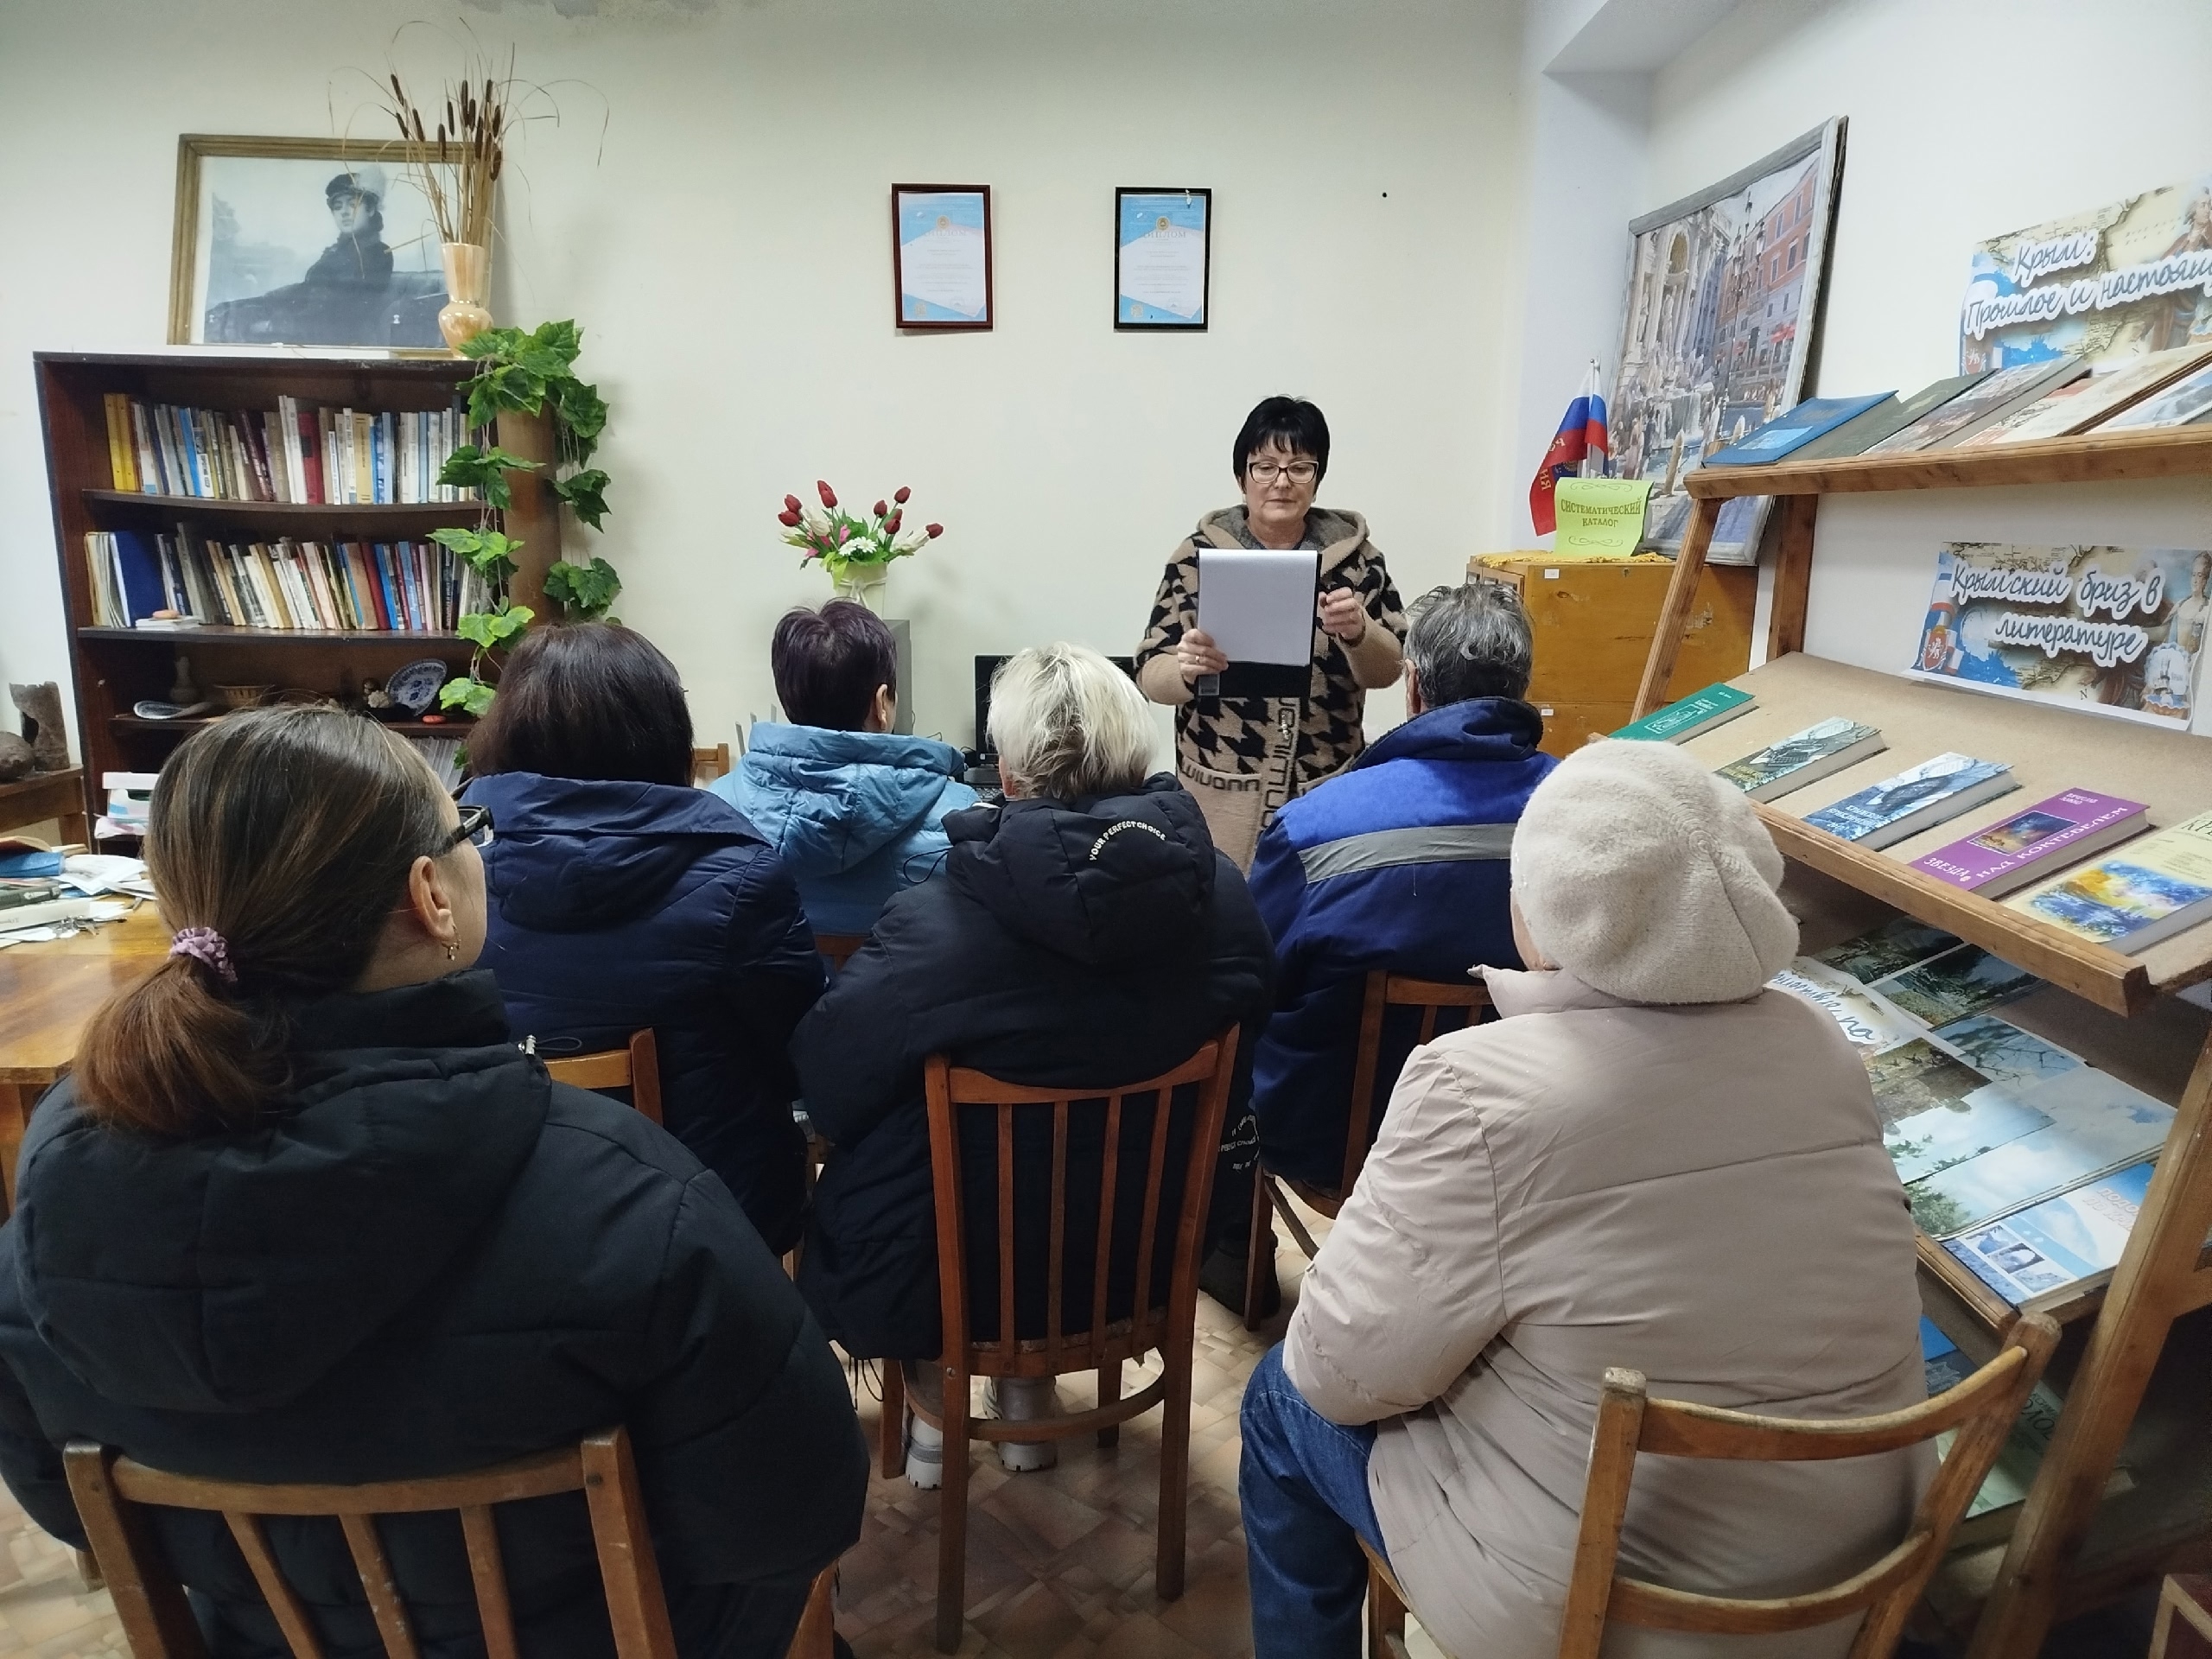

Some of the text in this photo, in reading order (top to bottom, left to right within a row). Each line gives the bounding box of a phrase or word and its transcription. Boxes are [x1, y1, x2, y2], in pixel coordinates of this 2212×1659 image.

[2015, 235, 2097, 278] Крым:
[1965, 288, 2063, 335] Прошлое
[2069, 286, 2094, 309] и
[1560, 496, 1643, 515] СИСТЕМАТИЧЕСКИЙ
[1582, 518, 1619, 528] КАТАЛОГ
[1952, 563, 2162, 612] Крымский бриз в
[1995, 617, 2143, 661] литературе
[1090, 821, 1166, 861] YOUR PERFECT CHOICE
[1923, 856, 1966, 877] ЗВЕЗДА
